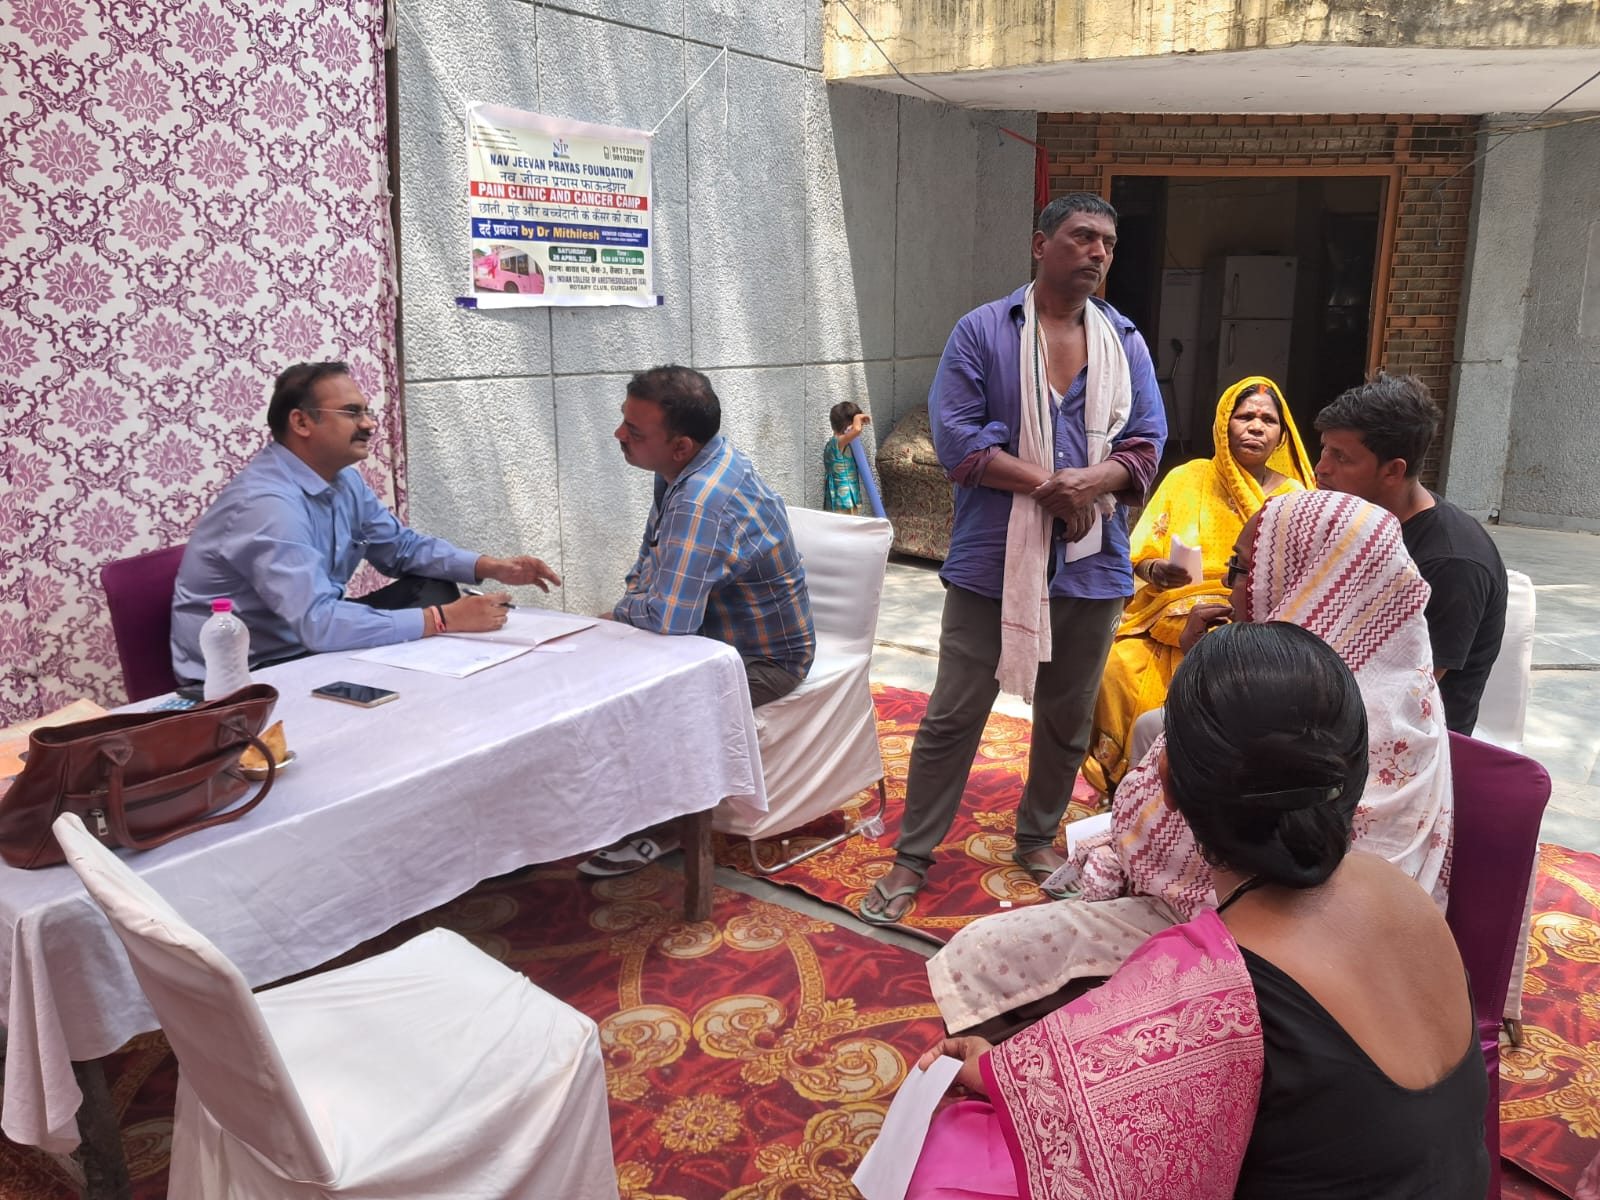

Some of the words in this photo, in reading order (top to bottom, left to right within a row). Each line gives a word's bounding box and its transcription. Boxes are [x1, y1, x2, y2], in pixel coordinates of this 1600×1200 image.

[490, 153, 510, 167] NAV
[512, 156, 546, 171] JEEVAN
[550, 160, 581, 174] PRAYAS
[583, 164, 634, 179] FOUNDATION
[500, 171, 517, 184] नव
[520, 170, 549, 185] जीवन
[551, 176, 579, 189] प्रयास
[478, 182, 505, 197] PAIN
[508, 185, 547, 201] CLINIC
[550, 189, 571, 203] AND
[573, 191, 614, 206] CANCER
[616, 196, 641, 209] CAMP
[522, 203, 541, 217] और
[493, 222, 519, 237] प्रबंधन
[520, 225, 534, 239] by
[537, 225, 550, 237] Dr
[553, 227, 600, 241] Mithilesh
[557, 247, 587, 256] SATURDAY
[561, 254, 577, 262] APRIL
